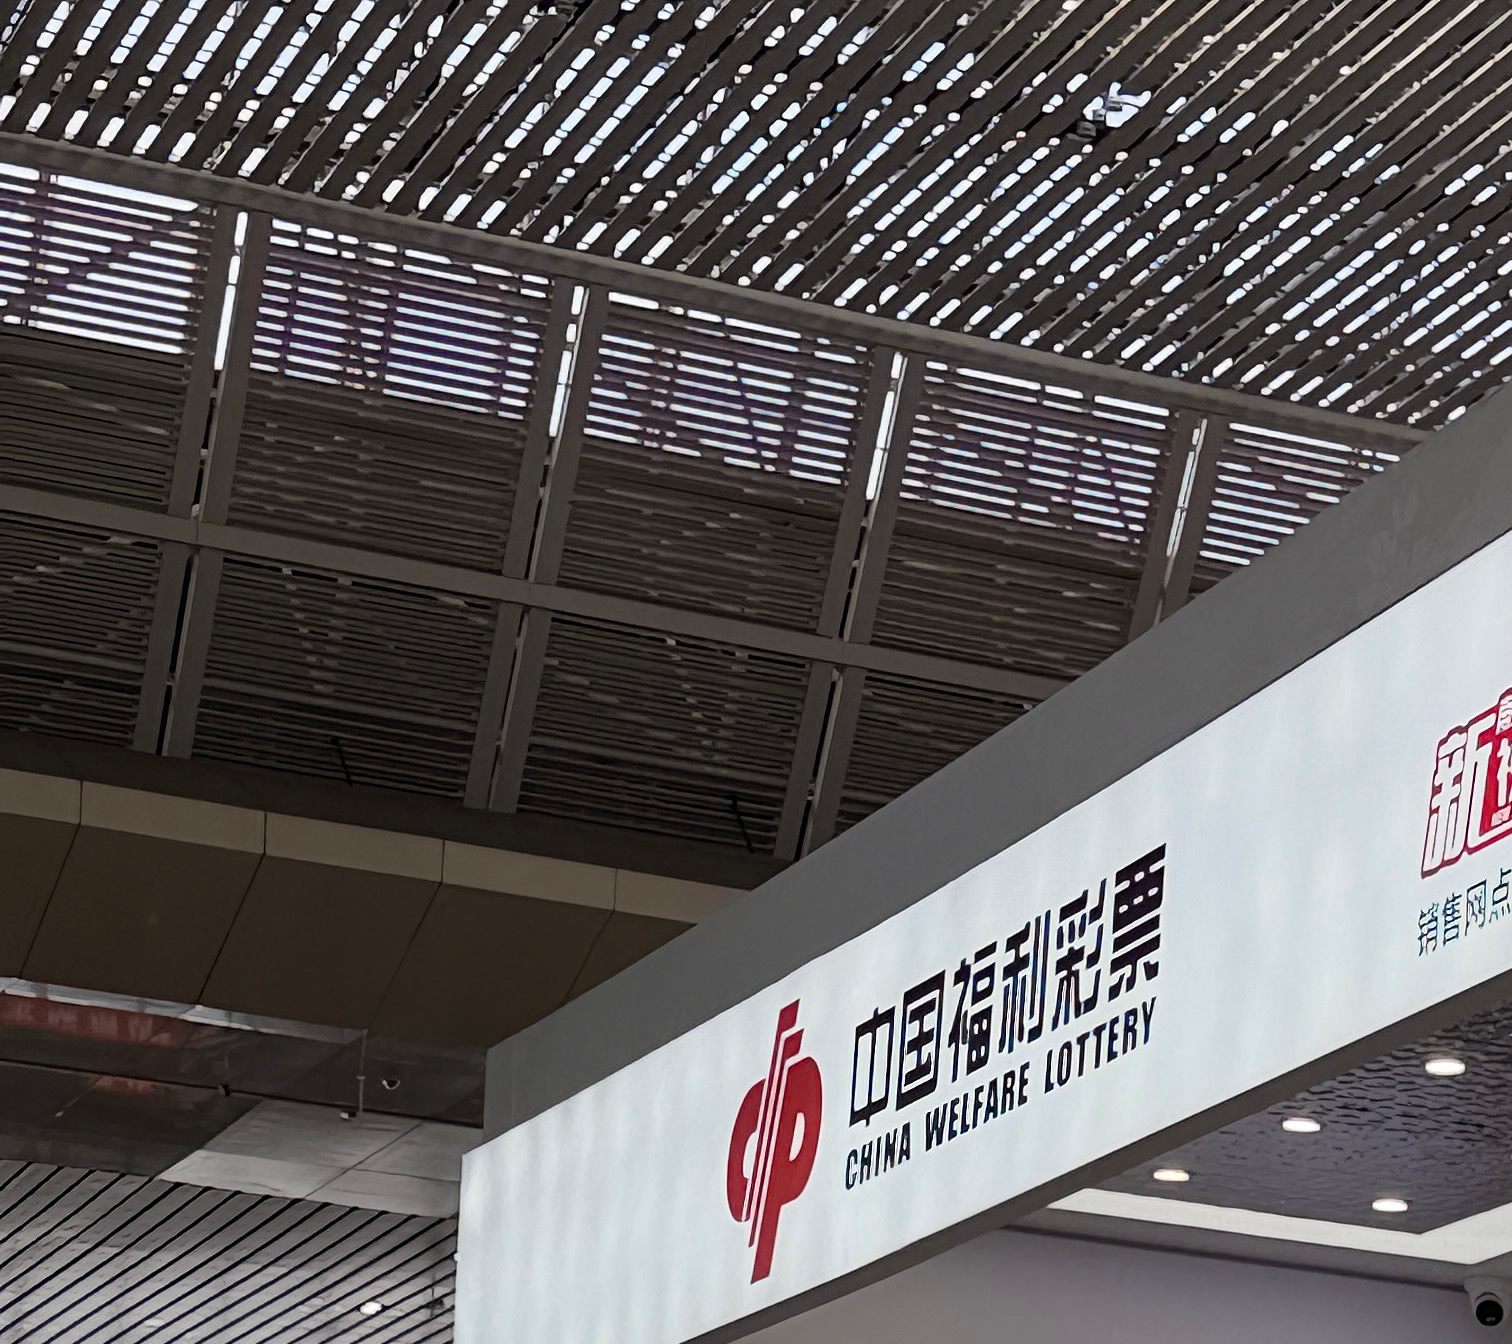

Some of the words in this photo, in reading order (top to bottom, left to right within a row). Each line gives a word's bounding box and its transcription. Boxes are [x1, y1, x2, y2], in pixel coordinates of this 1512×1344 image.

[844, 1122, 912, 1190] CHINA
[924, 1062, 1029, 1152] WELFARE
[1043, 995, 1158, 1094] LOTTERY
[848, 842, 1167, 1128] 中国福利彩票
